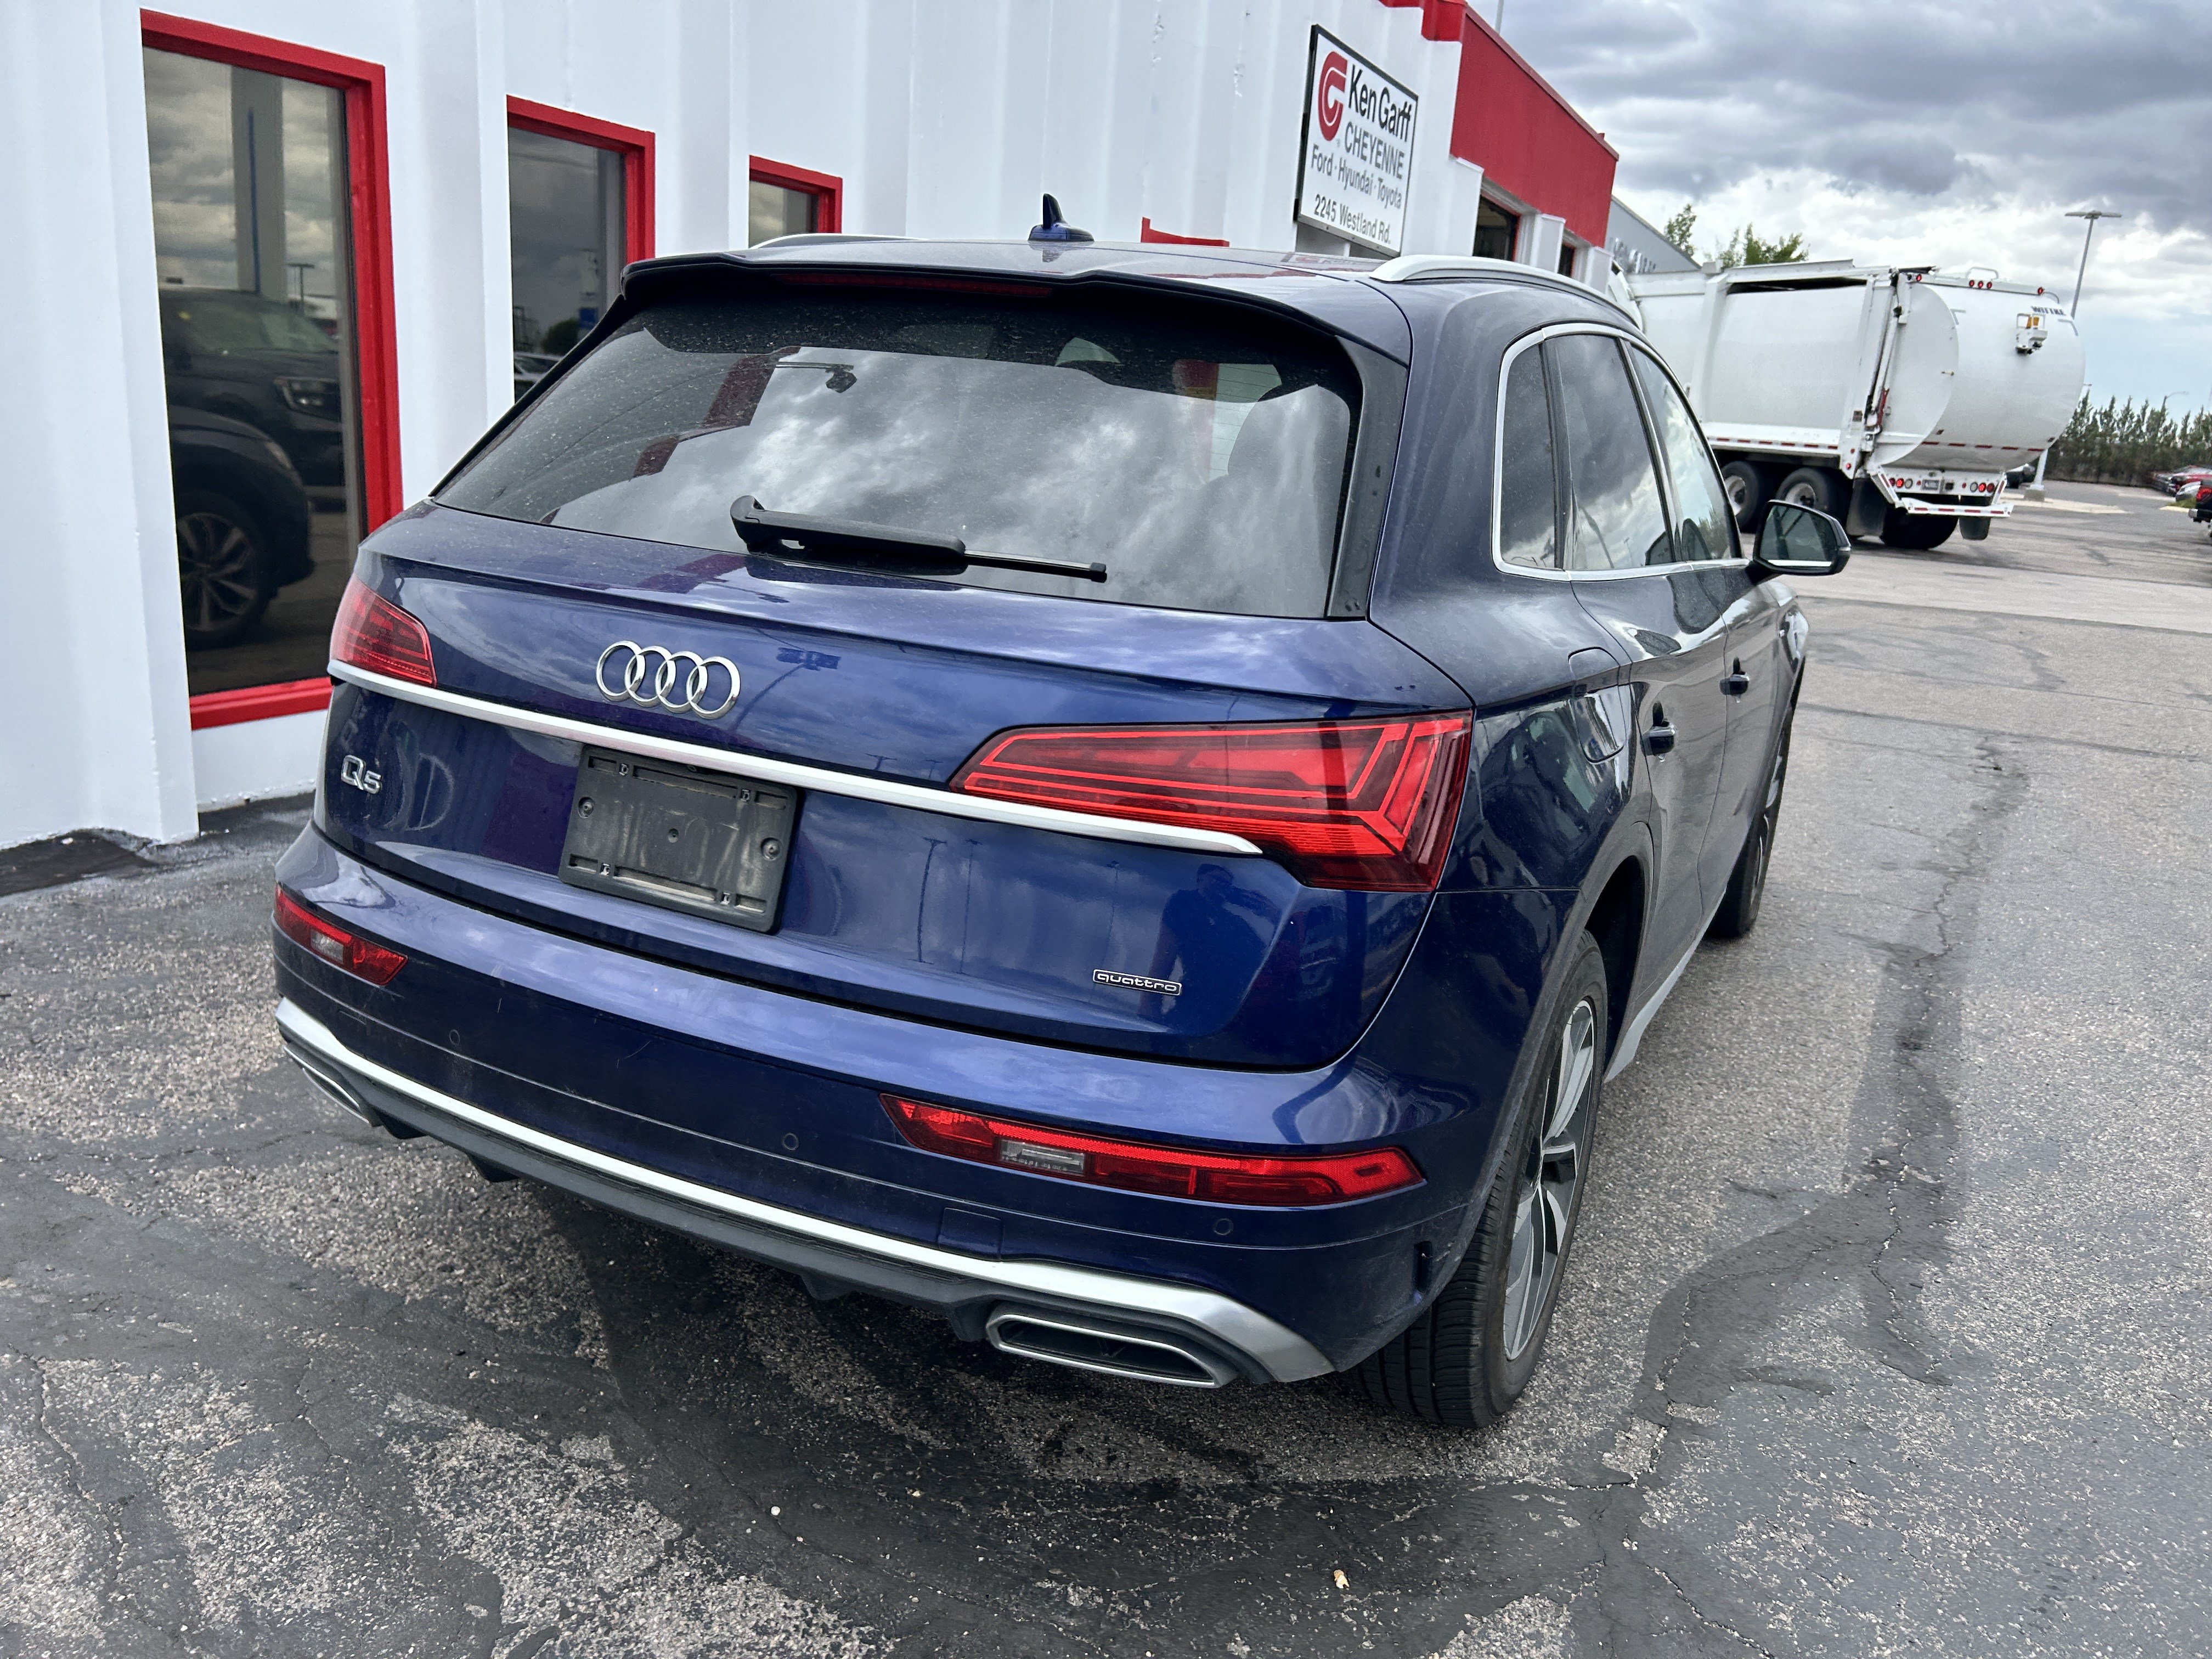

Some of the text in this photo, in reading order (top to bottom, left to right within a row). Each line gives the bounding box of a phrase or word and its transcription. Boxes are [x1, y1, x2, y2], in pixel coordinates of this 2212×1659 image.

[1348, 64, 1412, 142] Ken Garff
[1311, 143, 1402, 208] Ford Hyundai Toyota
[1345, 121, 1404, 180] CHEYENNE
[1314, 194, 1391, 244] 2245 Westland Rd.
[341, 755, 382, 794] Q5
[1097, 973, 1177, 992] quattro
